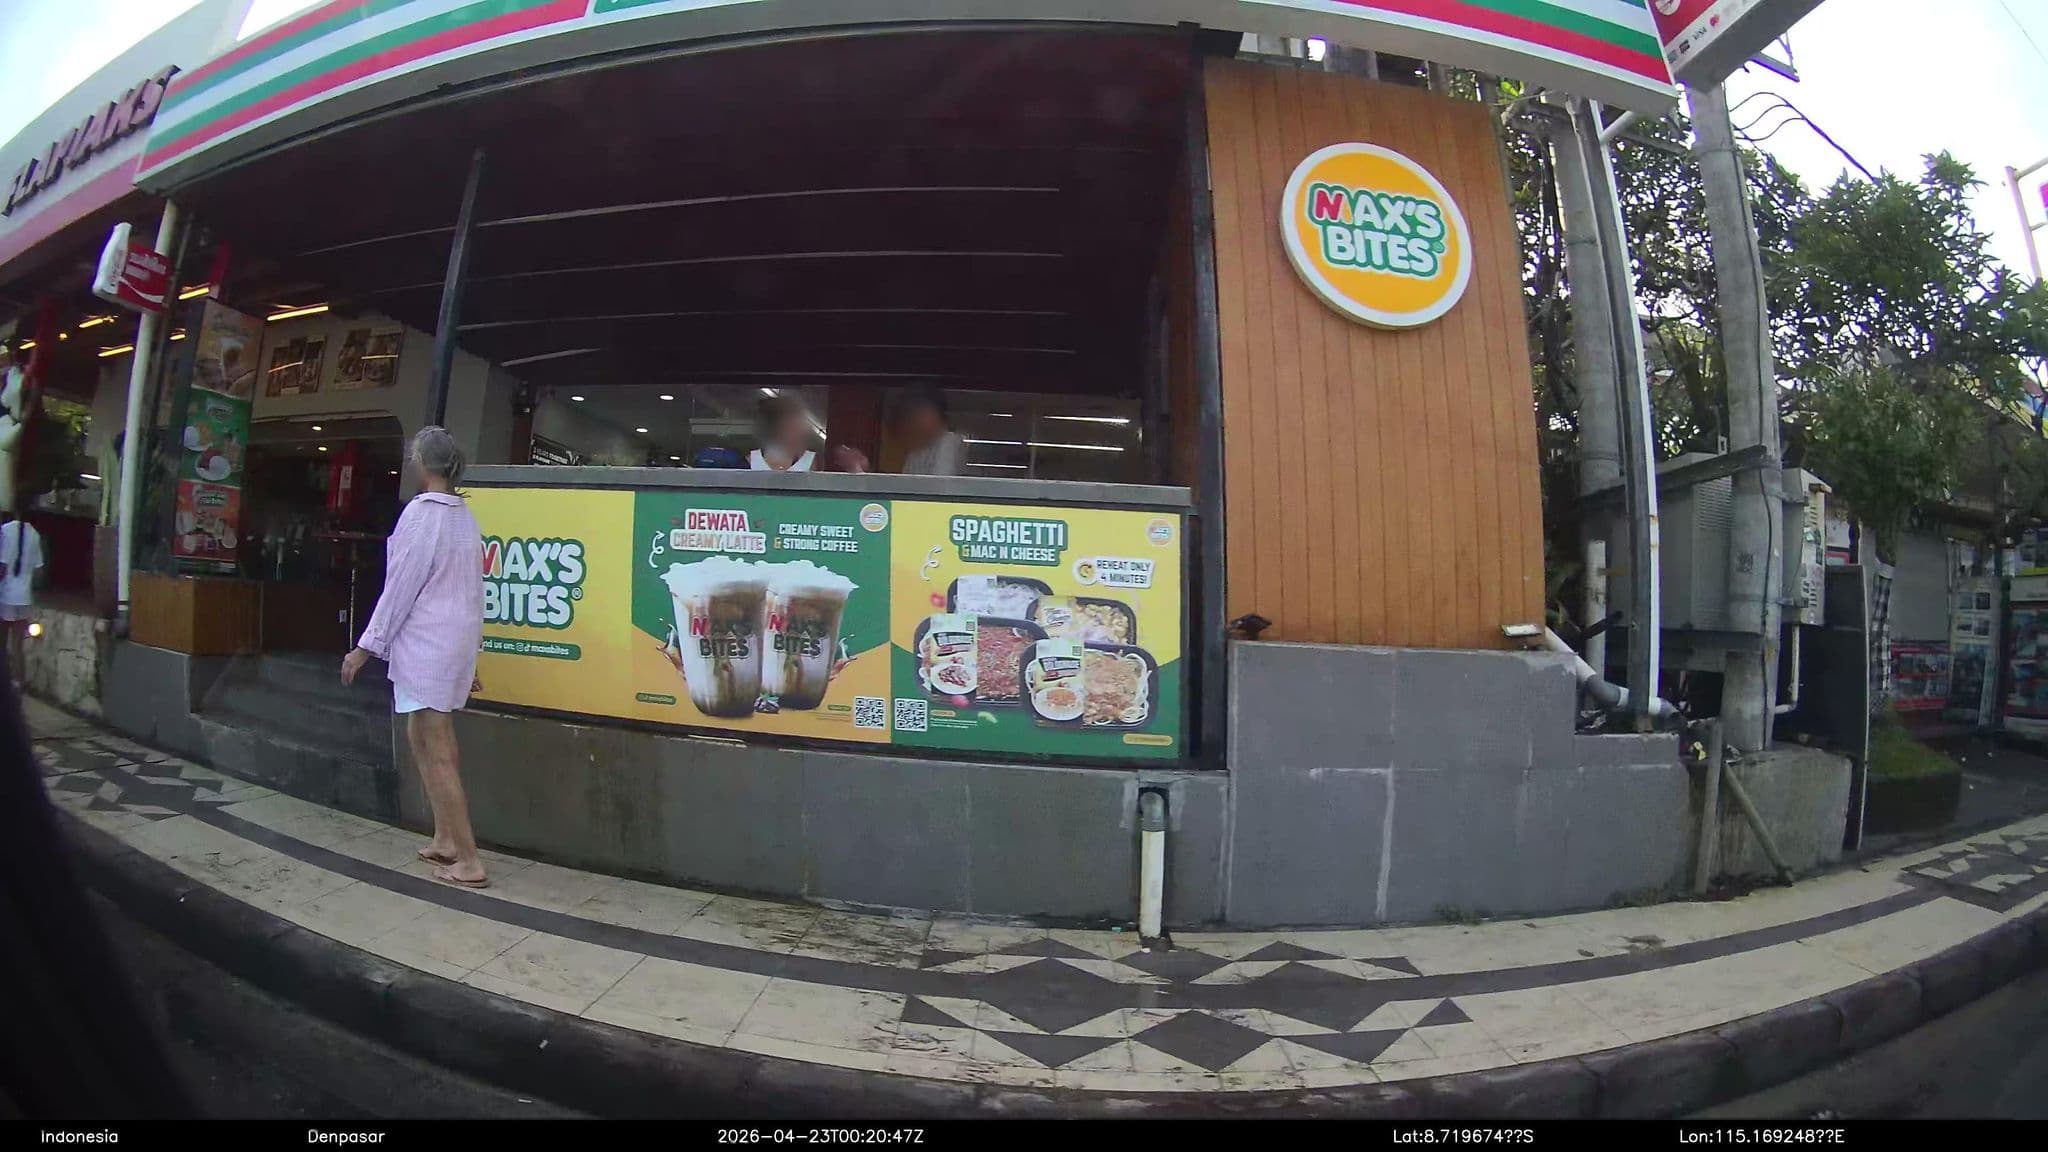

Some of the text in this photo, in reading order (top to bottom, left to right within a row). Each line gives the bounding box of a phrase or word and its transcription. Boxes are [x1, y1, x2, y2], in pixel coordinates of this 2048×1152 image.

[1314, 190, 1442, 238] MAX'S
[1327, 225, 1434, 273] BITES
[688, 512, 747, 531] DEWATA
[779, 523, 853, 537] CREAMY SWEET
[673, 532, 764, 551] CREAMY LATTE
[952, 518, 1063, 546] SPAGHETTI
[783, 538, 819, 550] STRONG
[821, 540, 858, 552] COFFEE
[970, 545, 996, 558] MAC
[999, 546, 1008, 559] N
[1010, 546, 1056, 561] CHEESE
[1097, 559, 1151, 571] REHEAT ONLY
[483, 582, 571, 626] BITES
[700, 637, 750, 657] BITES
[774, 633, 821, 656] BITES
